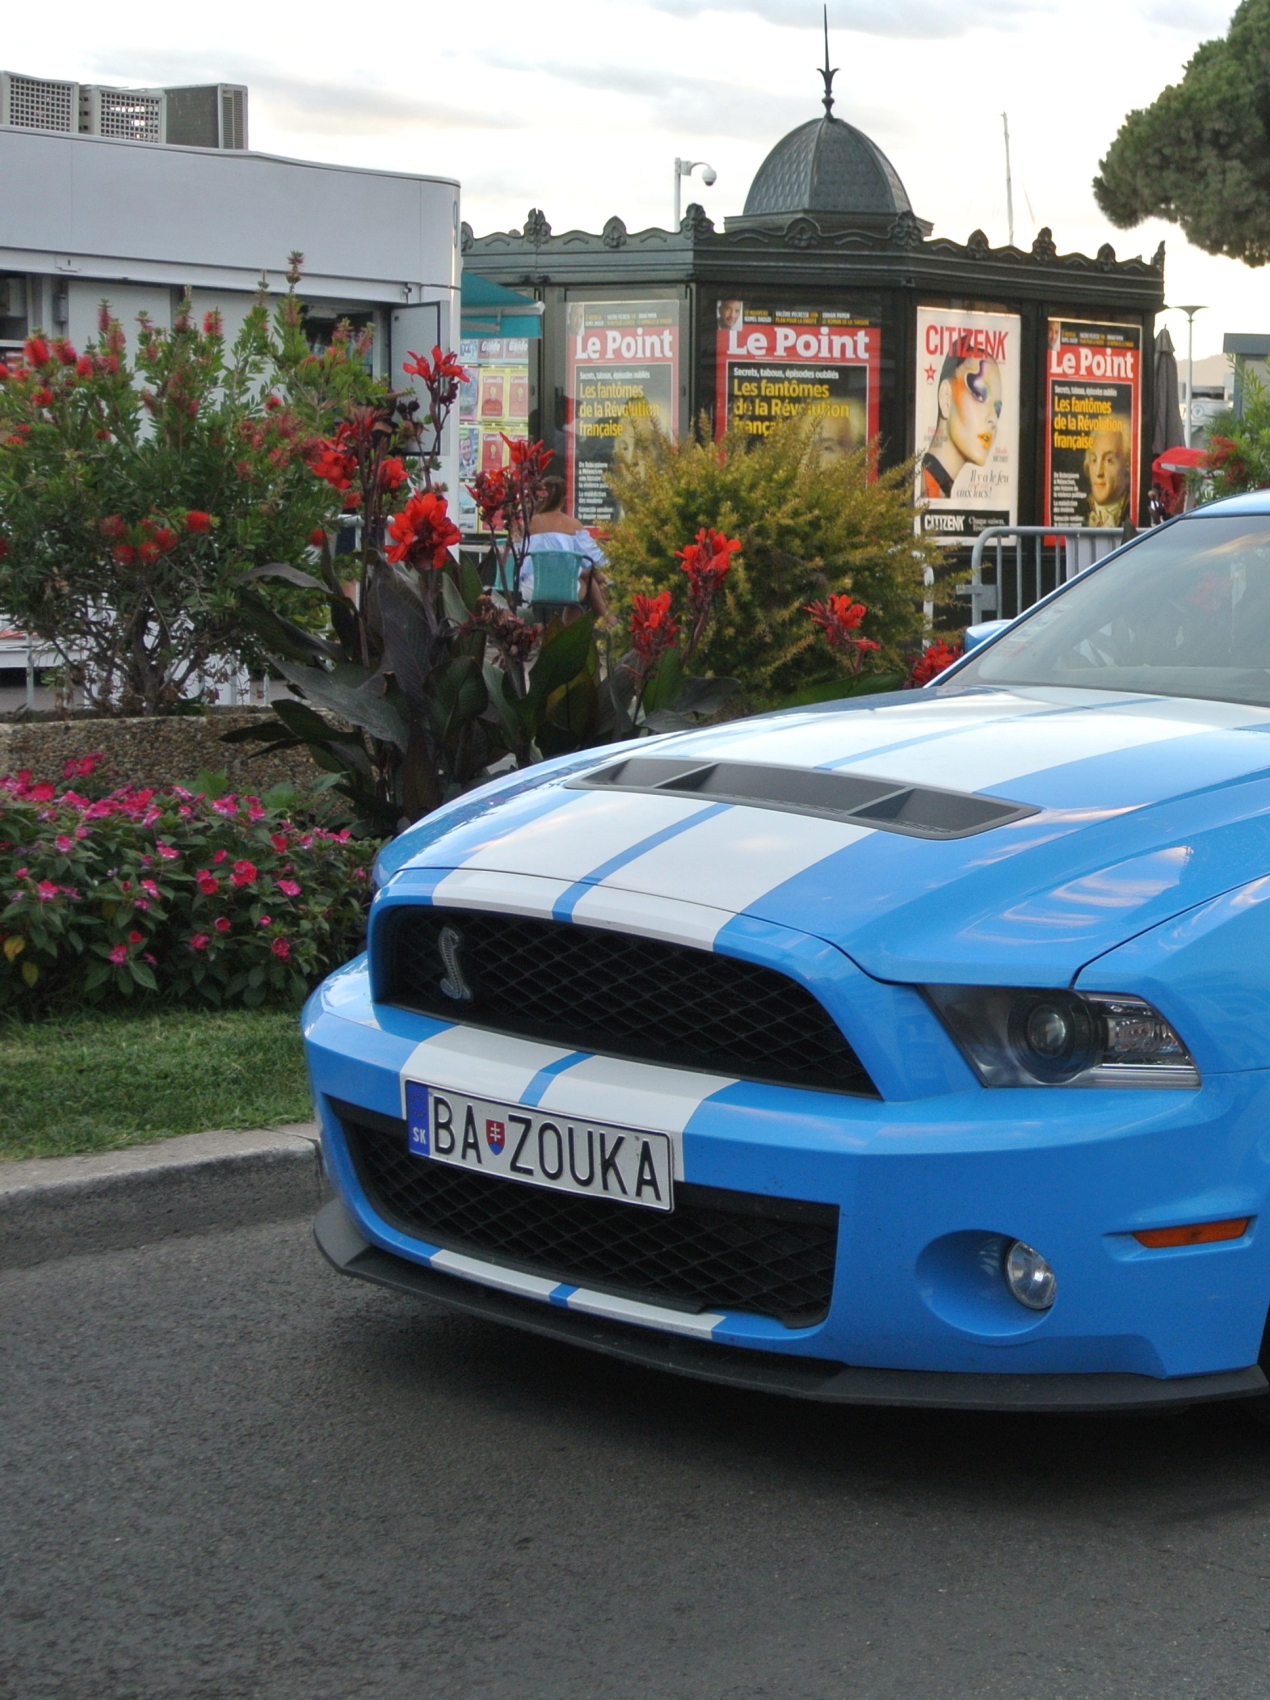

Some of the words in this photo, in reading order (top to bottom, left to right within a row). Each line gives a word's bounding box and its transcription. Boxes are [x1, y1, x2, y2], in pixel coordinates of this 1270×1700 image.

[575, 335, 601, 359] Le
[605, 327, 673, 358] Point
[727, 330, 768, 356] Le
[774, 326, 870, 359] Point
[925, 325, 1009, 360] CITIZENK
[1050, 350, 1076, 375] Le
[1079, 347, 1134, 379] Point
[733, 367, 759, 378] Secrets,
[760, 368, 784, 379] tabous,
[785, 369, 814, 380] épisodes
[580, 382, 596, 398] Les
[597, 381, 643, 399] fantômes
[733, 378, 758, 396] Les
[760, 378, 830, 398] fantômes
[579, 401, 593, 417] de
[594, 401, 603, 417] la
[604, 401, 660, 417] Révolution
[733, 398, 752, 416] de
[754, 398, 768, 416] la
[1054, 395, 1070, 412] Les
[1071, 396, 1113, 414] fantômes
[580, 420, 624, 439] française
[1054, 414, 1067, 430] de
[1067, 414, 1077, 431] la
[1077, 414, 1123, 433] Révolution
[1054, 431, 1094, 450] française
[924, 514, 965, 532] CITIZENK
[412, 1126, 427, 1145] SK
[432, 1096, 483, 1164] BA
[508, 1113, 662, 1201] ZOUKA
